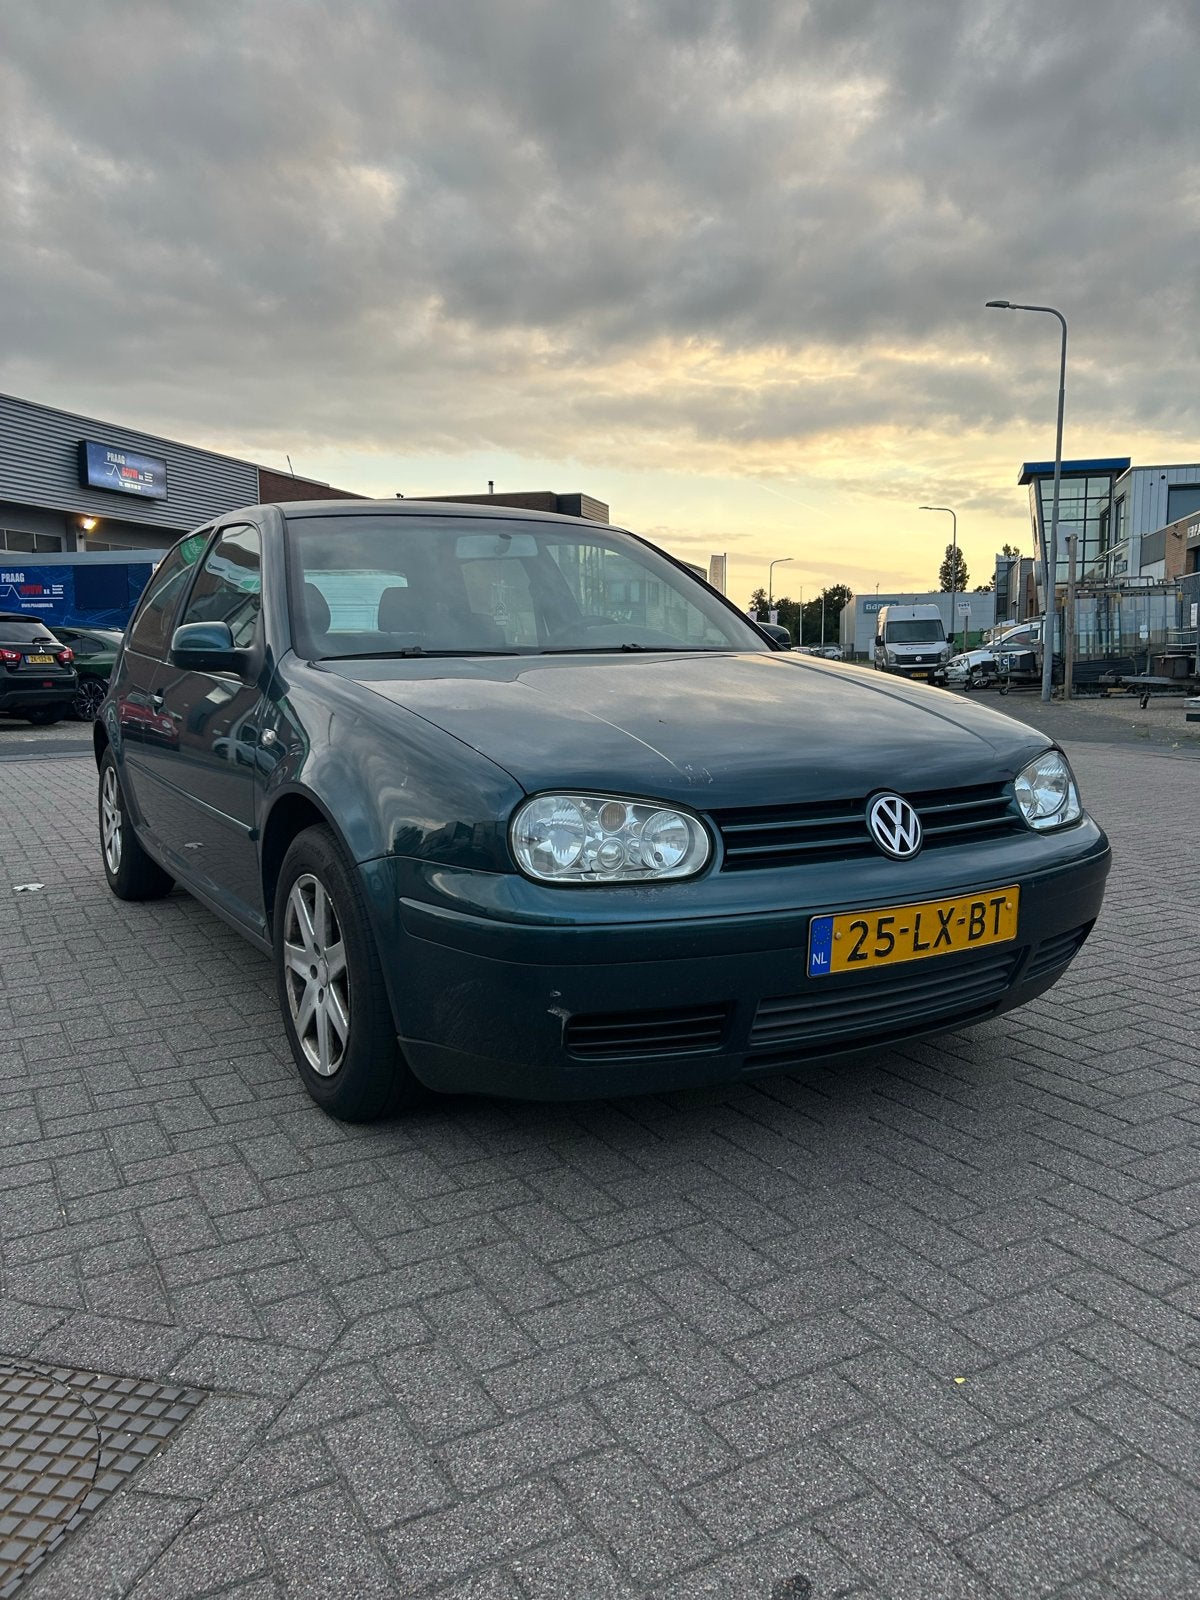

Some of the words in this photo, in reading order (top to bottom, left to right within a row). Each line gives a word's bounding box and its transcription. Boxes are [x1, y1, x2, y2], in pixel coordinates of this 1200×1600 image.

[106, 452, 126, 465] PRAAG
[1, 573, 25, 583] PRAAG
[847, 897, 1006, 962] 25-LX-BT
[812, 952, 828, 966] NL
